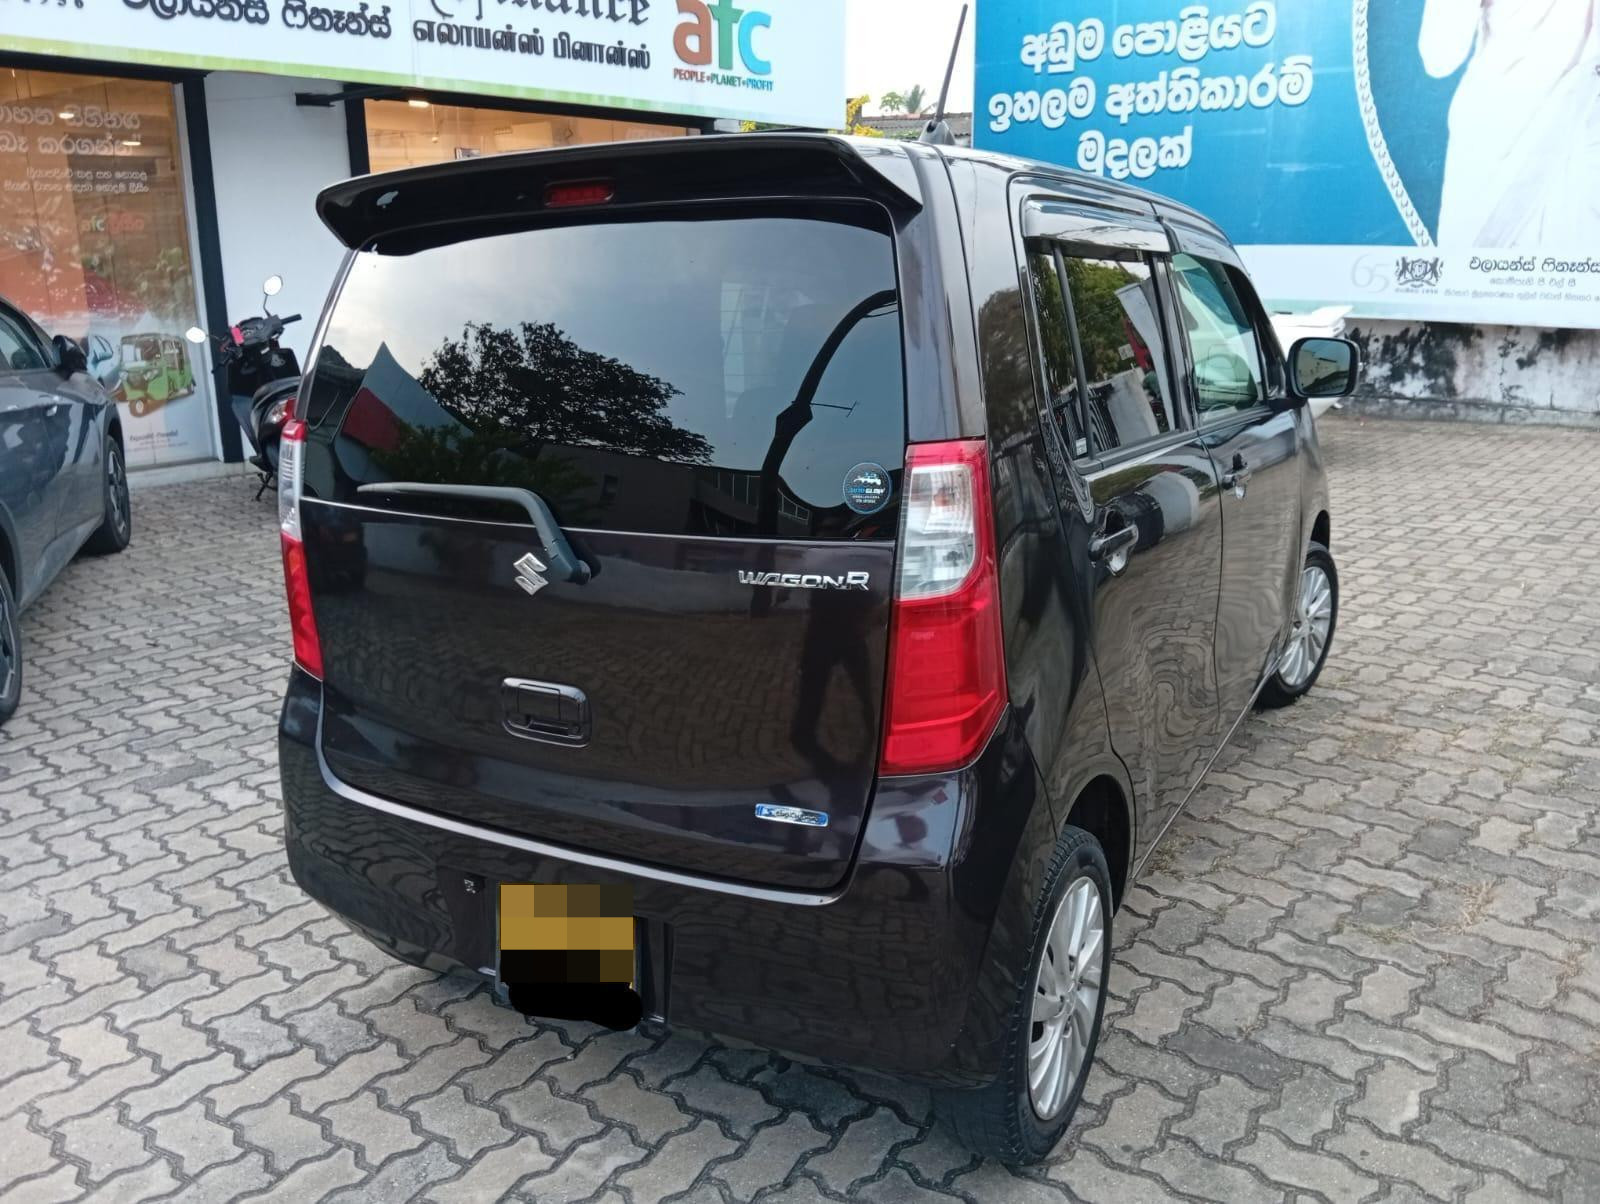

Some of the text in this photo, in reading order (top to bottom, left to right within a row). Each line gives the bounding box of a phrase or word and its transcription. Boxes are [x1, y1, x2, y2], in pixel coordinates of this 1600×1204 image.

[413, 18, 650, 70] எலாயன்ஸ் பினான்ஸ்
[1020, 1, 1277, 74] අඩුම පොළියට
[673, 68, 774, 92] PEOPLE PLANET PROFIT
[988, 54, 1314, 133] ඉහලම අත්තිකාරම්
[1077, 125, 1194, 180] මුදලක්
[1351, 254, 1391, 293] 65
